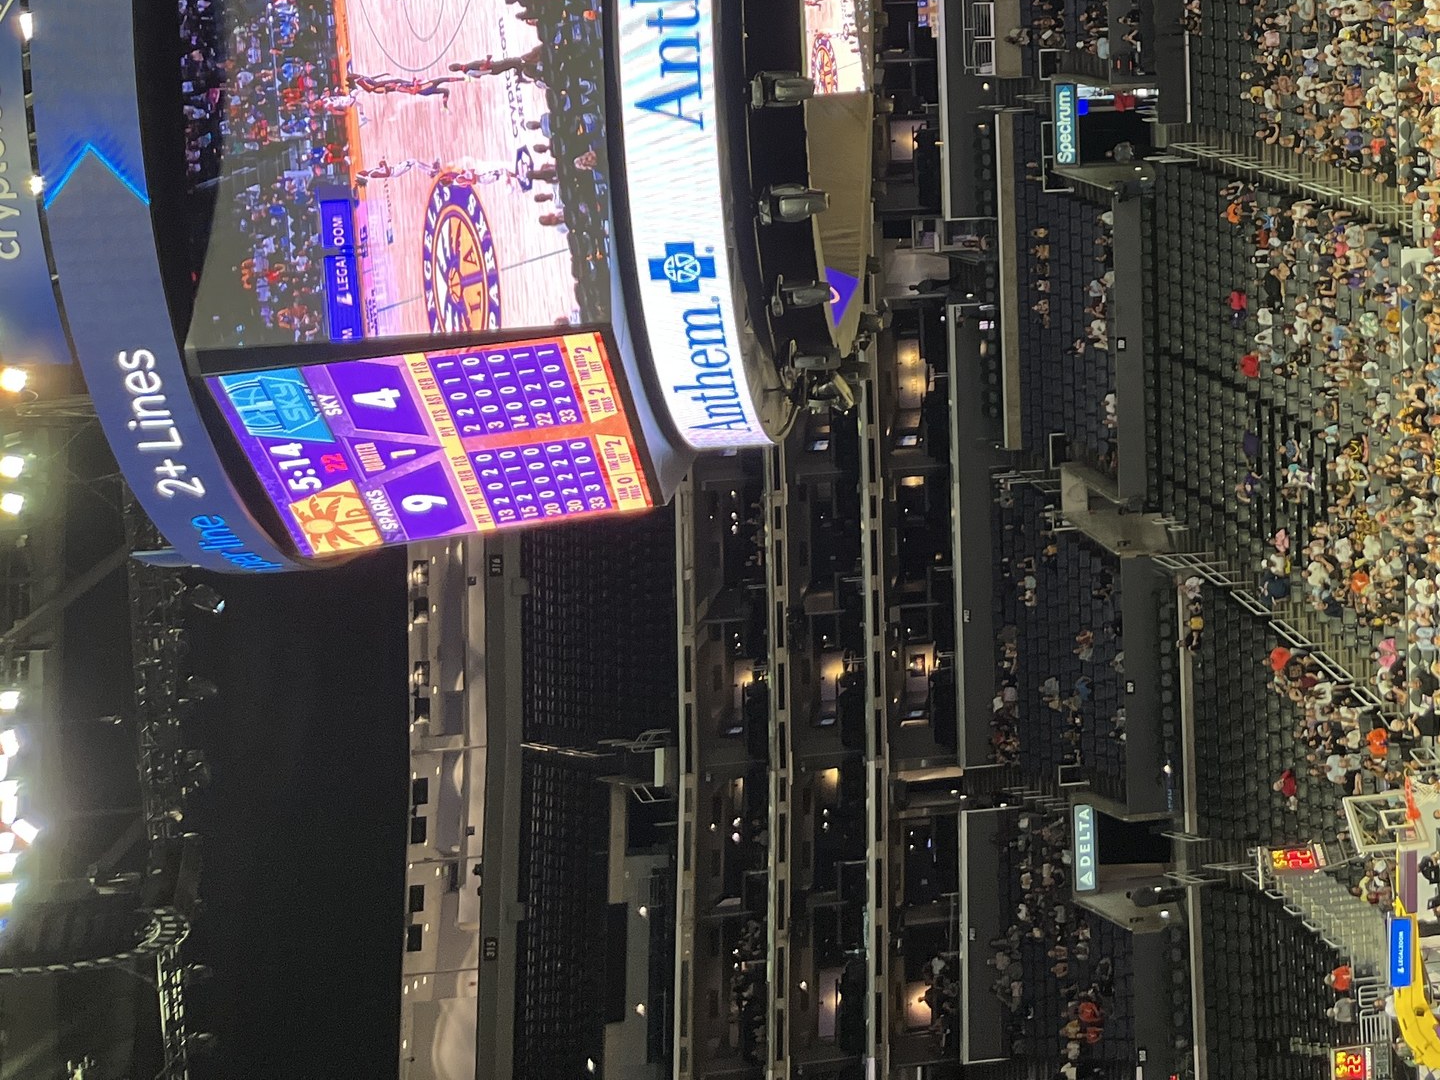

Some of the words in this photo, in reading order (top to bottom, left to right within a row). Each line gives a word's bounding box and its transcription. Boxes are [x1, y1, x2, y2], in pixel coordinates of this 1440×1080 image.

[1057, 92, 1075, 162] Spectrum
[673, 303, 751, 432] Anthem
[117, 349, 182, 451] Lines
[318, 394, 343, 416] SKY
[352, 388, 401, 408] 4
[270, 442, 322, 490] 5:14
[320, 453, 348, 472] 22
[354, 442, 386, 472] QUARTER
[390, 449, 416, 458] 1
[155, 459, 205, 498] 2+
[366, 490, 399, 530] SPARKS
[401, 494, 448, 512] 9
[191, 515, 244, 551] line
[222, 552, 283, 572] per
[1079, 808, 1090, 866] DELTA
